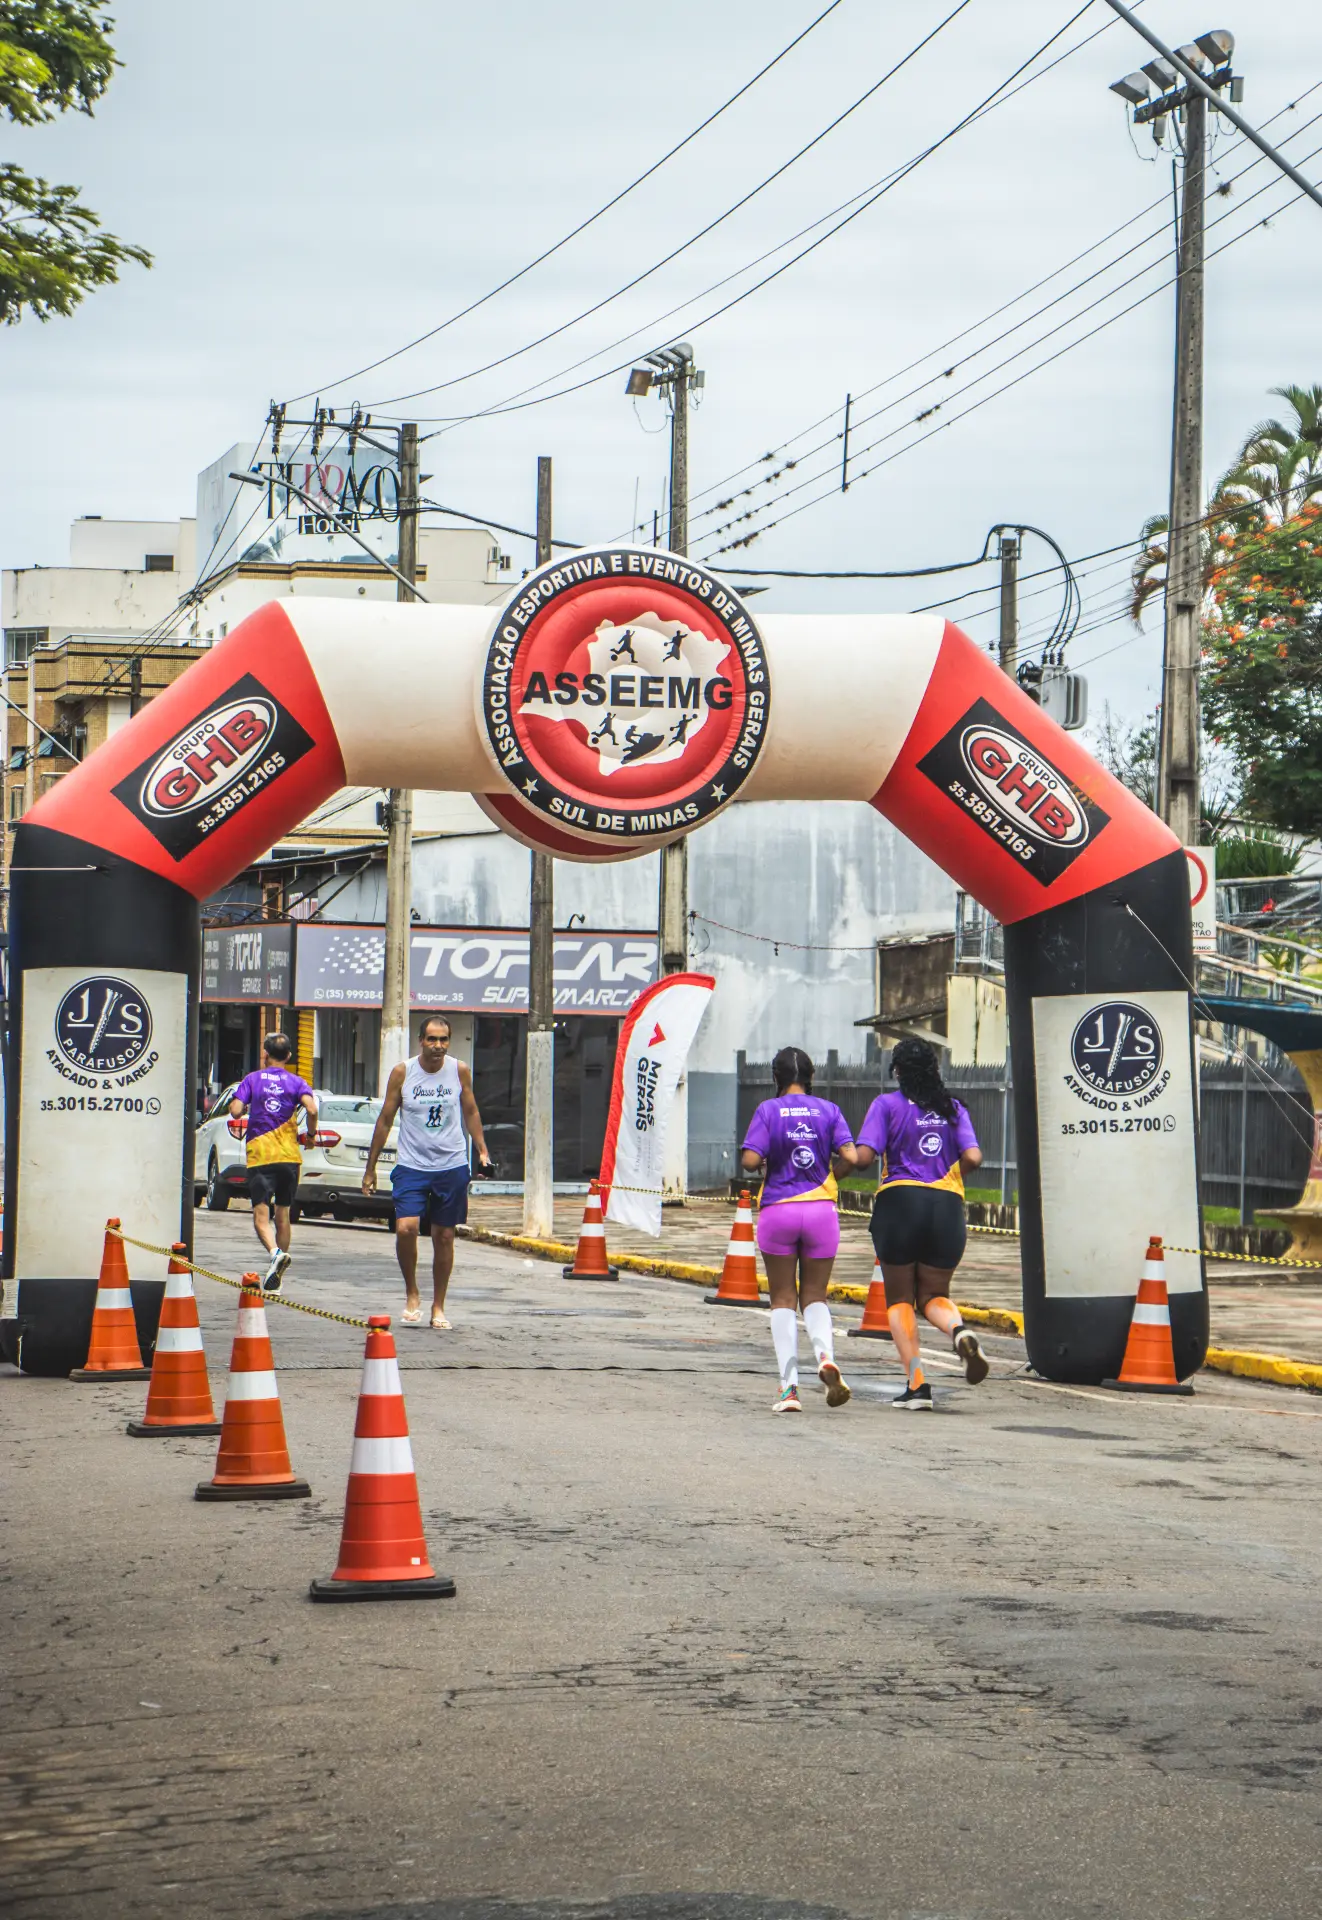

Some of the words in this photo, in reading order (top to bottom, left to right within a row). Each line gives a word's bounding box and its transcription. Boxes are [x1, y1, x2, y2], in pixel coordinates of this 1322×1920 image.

[611, 555, 622, 572] E
[629, 554, 713, 598] EVENTOS
[513, 556, 607, 627] ESPORTIVA
[711, 590, 738, 619] DE
[731, 617, 765, 683] MINAS
[491, 626, 523, 768] ASSOCIAÇÃO
[521, 670, 734, 711] ASSEEMG
[172, 723, 215, 760] GRUPO
[732, 690, 765, 769] GERAIS
[154, 709, 269, 809] GHB
[1018, 752, 1058, 790] GRUPO
[197, 751, 287, 833] 35.3851.2165
[970, 737, 1075, 839] GHB
[549, 796, 590, 826] SUL
[595, 811, 625, 831] DE
[631, 802, 700, 832] MINAS
[948, 780, 1036, 860] 35.3851.2165
[411, 936, 658, 983] TOPCAR
[326, 989, 344, 1000] (35)
[346, 990, 384, 1000] 99938-0
[417, 992, 464, 1004] topcar_35
[481, 986, 641, 1007] SUPMARCA
[46, 1049, 98, 1089] ATACADO
[102, 1079, 112, 1090] &
[115, 1050, 160, 1088] VAREJO
[63, 1037, 142, 1069] PARAFUSOS
[635, 1057, 649, 1132] GERAIS
[646, 1060, 662, 1127] MINAS
[1063, 1073, 1117, 1111] ATACADO
[1121, 1101, 1132, 1111] &
[1134, 1069, 1172, 1108] VAREJO
[1080, 1061, 1155, 1092] PARAFUSOS
[40, 1096, 144, 1113] 35.3015.2700
[1061, 1117, 1161, 1135] 35.3015.2700
